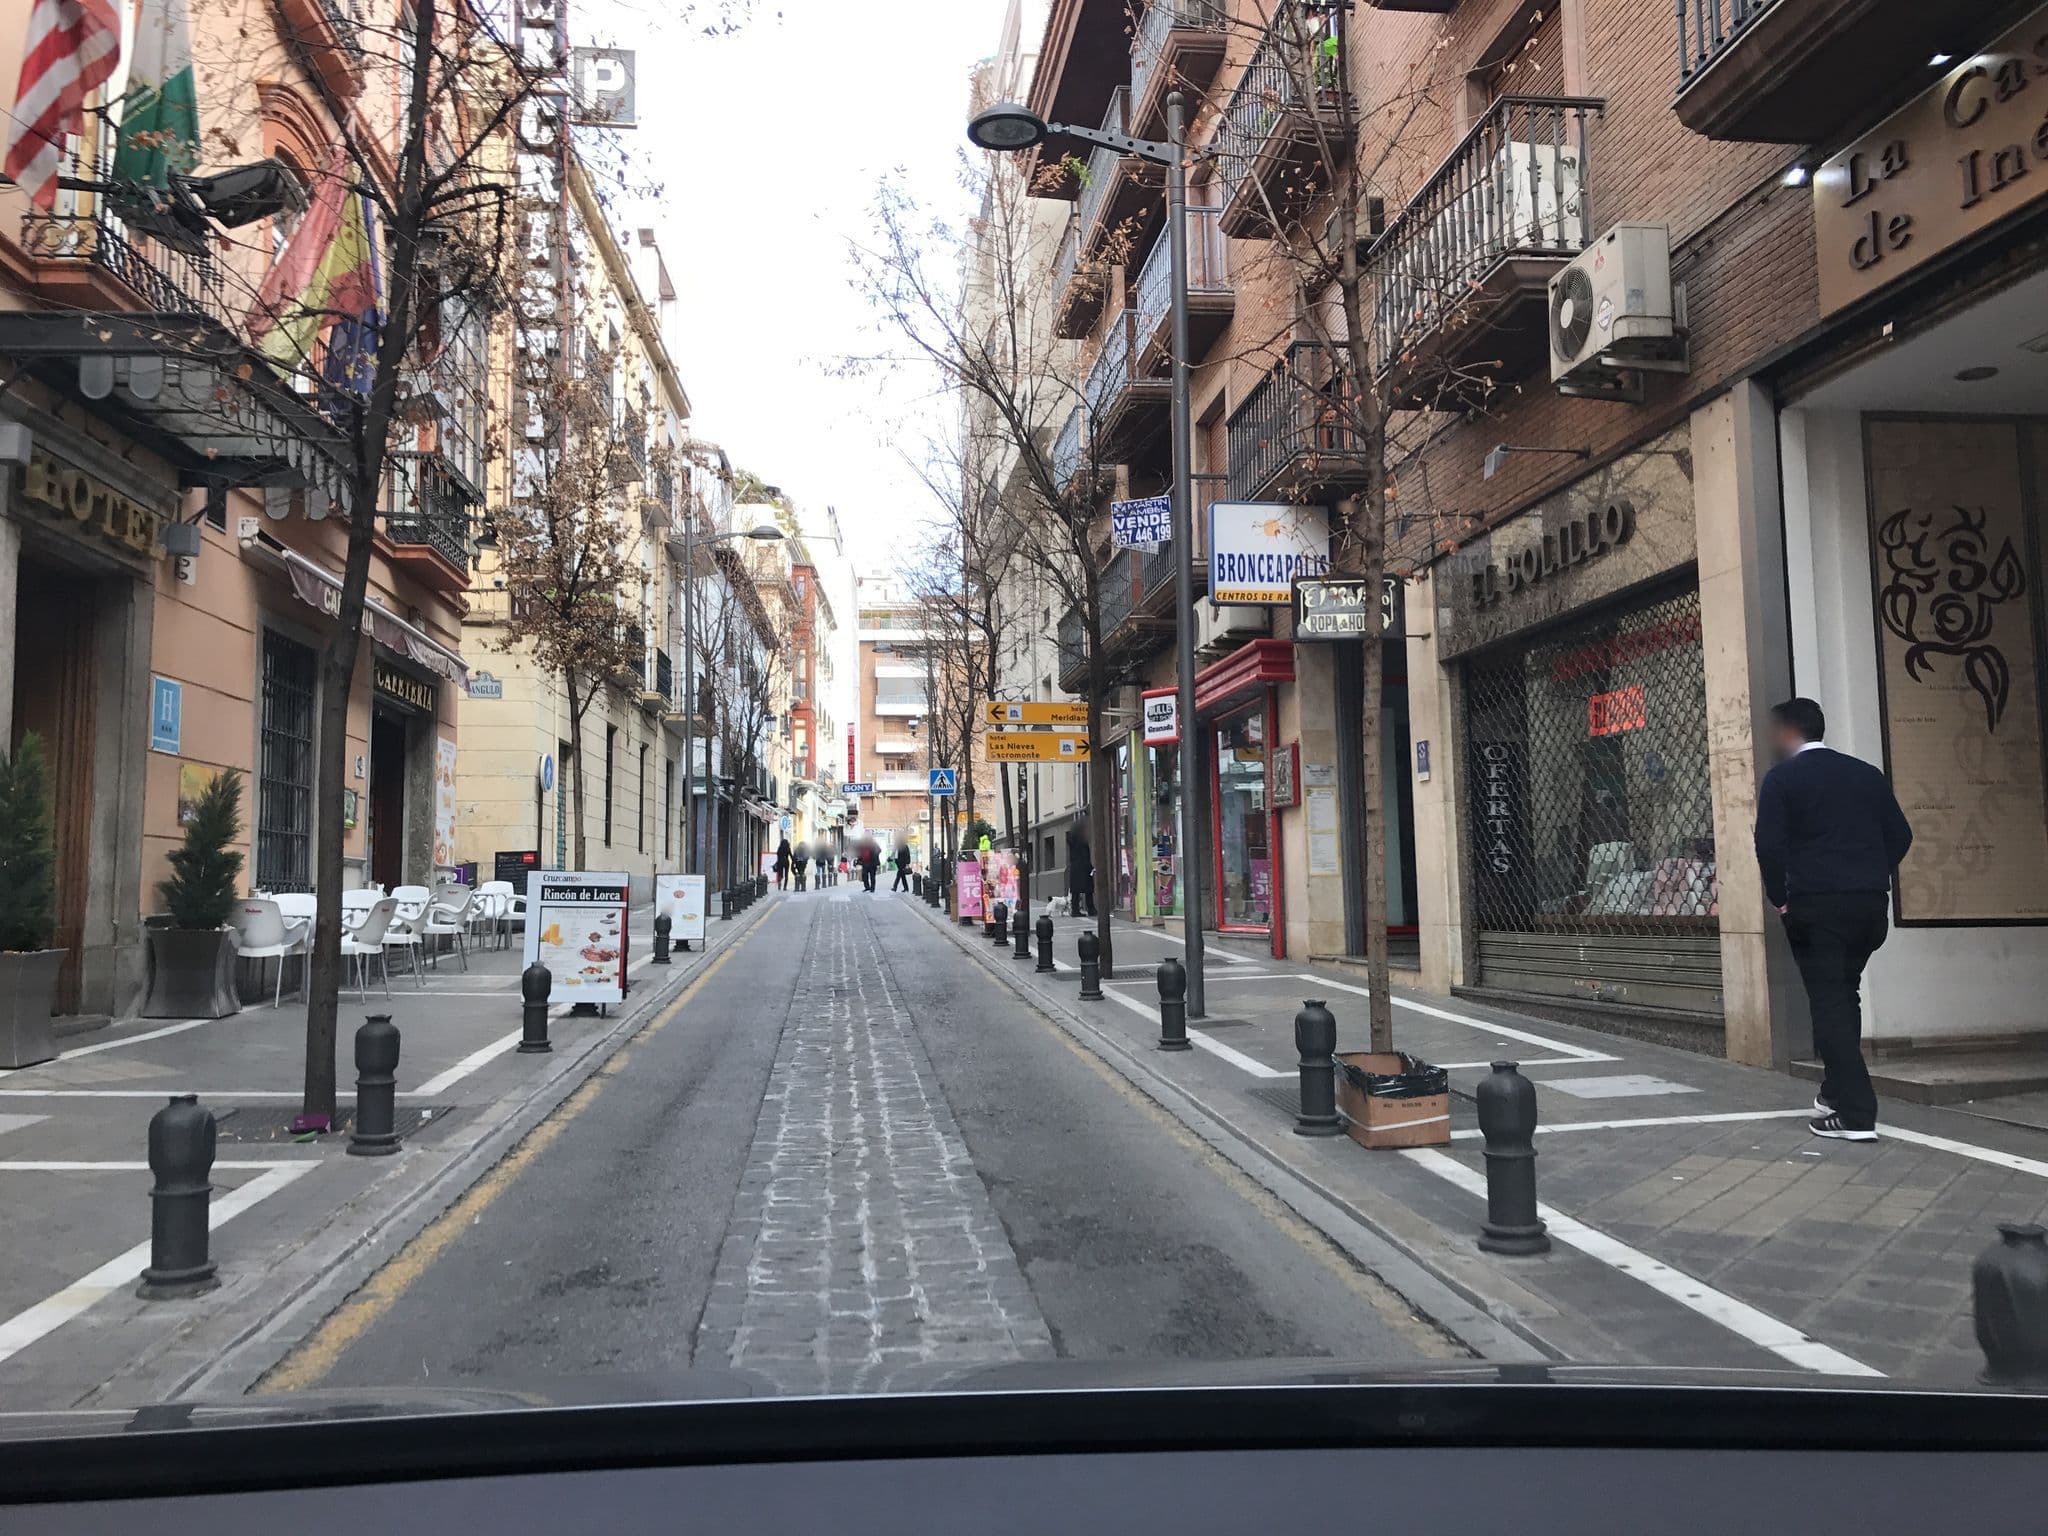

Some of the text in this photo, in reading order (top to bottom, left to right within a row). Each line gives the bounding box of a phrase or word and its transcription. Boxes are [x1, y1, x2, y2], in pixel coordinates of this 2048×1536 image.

[583, 57, 626, 118] P
[1839, 139, 1910, 208] La
[1848, 209, 1914, 270] de
[24, 459, 167, 562] HOTEL
[1114, 512, 1171, 530] VENDE
[1115, 524, 1172, 546] 657 446 199
[1470, 496, 1636, 610] EL BOLILLO
[1216, 591, 1289, 602] CENTROS DE RA
[1304, 586, 1326, 608] El
[1310, 614, 1338, 632] ROPA
[376, 667, 433, 713] CAFETERIA
[162, 688, 174, 722] H
[989, 742, 1035, 750] Las Nieves
[844, 784, 872, 792] SONY
[1484, 744, 1512, 873] OFERTAS
[543, 874, 582, 883] Cruzcampo
[543, 888, 621, 901] Rincón de Lorca
